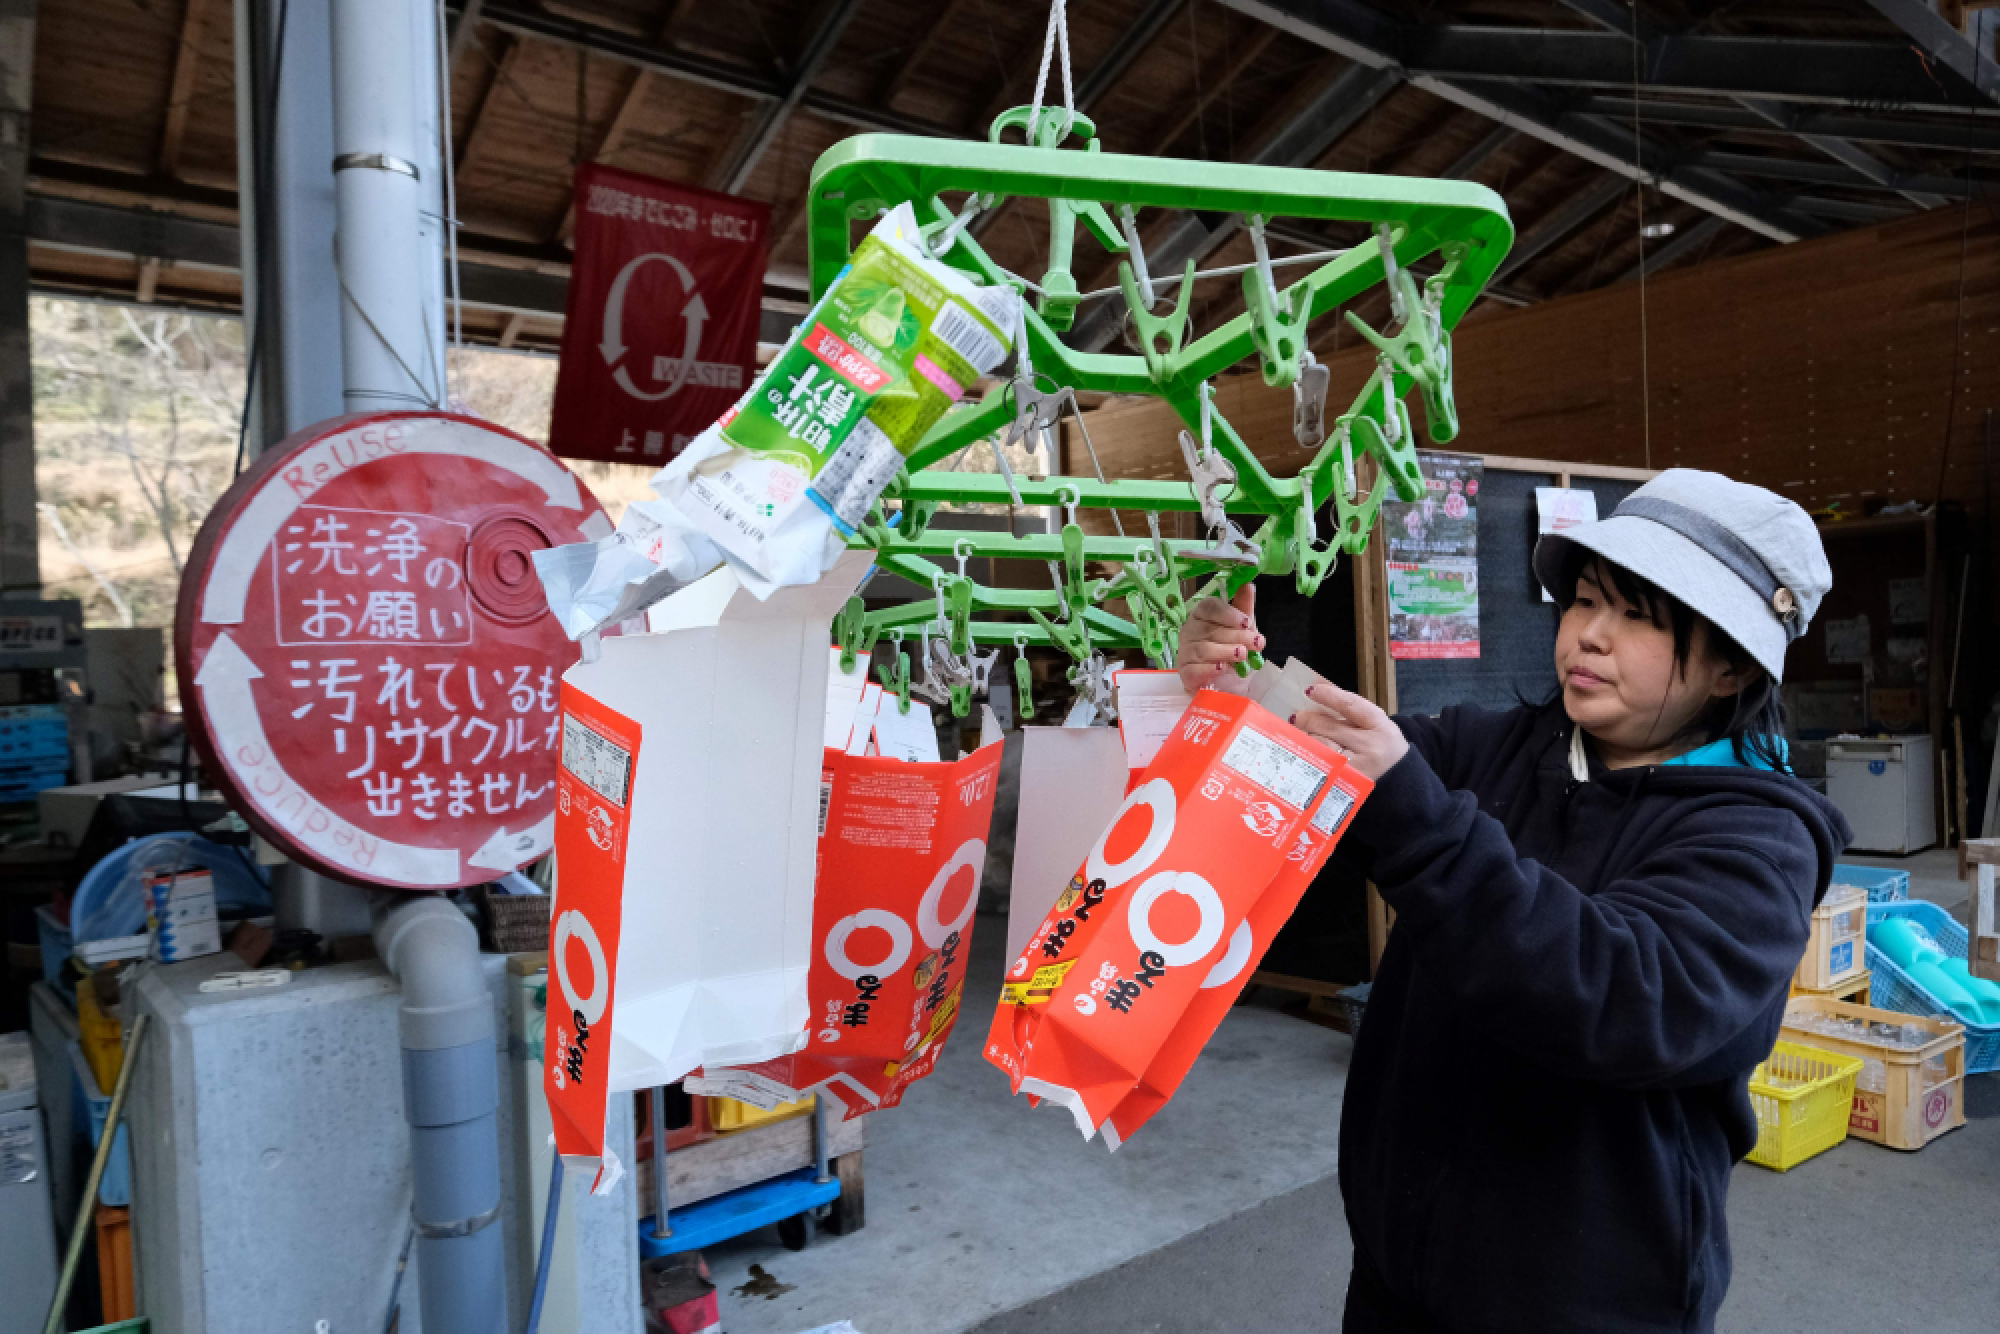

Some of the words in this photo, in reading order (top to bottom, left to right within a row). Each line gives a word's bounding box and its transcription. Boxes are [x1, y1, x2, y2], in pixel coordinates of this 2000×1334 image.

[659, 357, 741, 387] WASTE
[286, 513, 462, 589] 洗浄の
[301, 589, 464, 639] お願い
[291, 655, 558, 723] 汚れているも
[237, 742, 380, 867] Reduce
